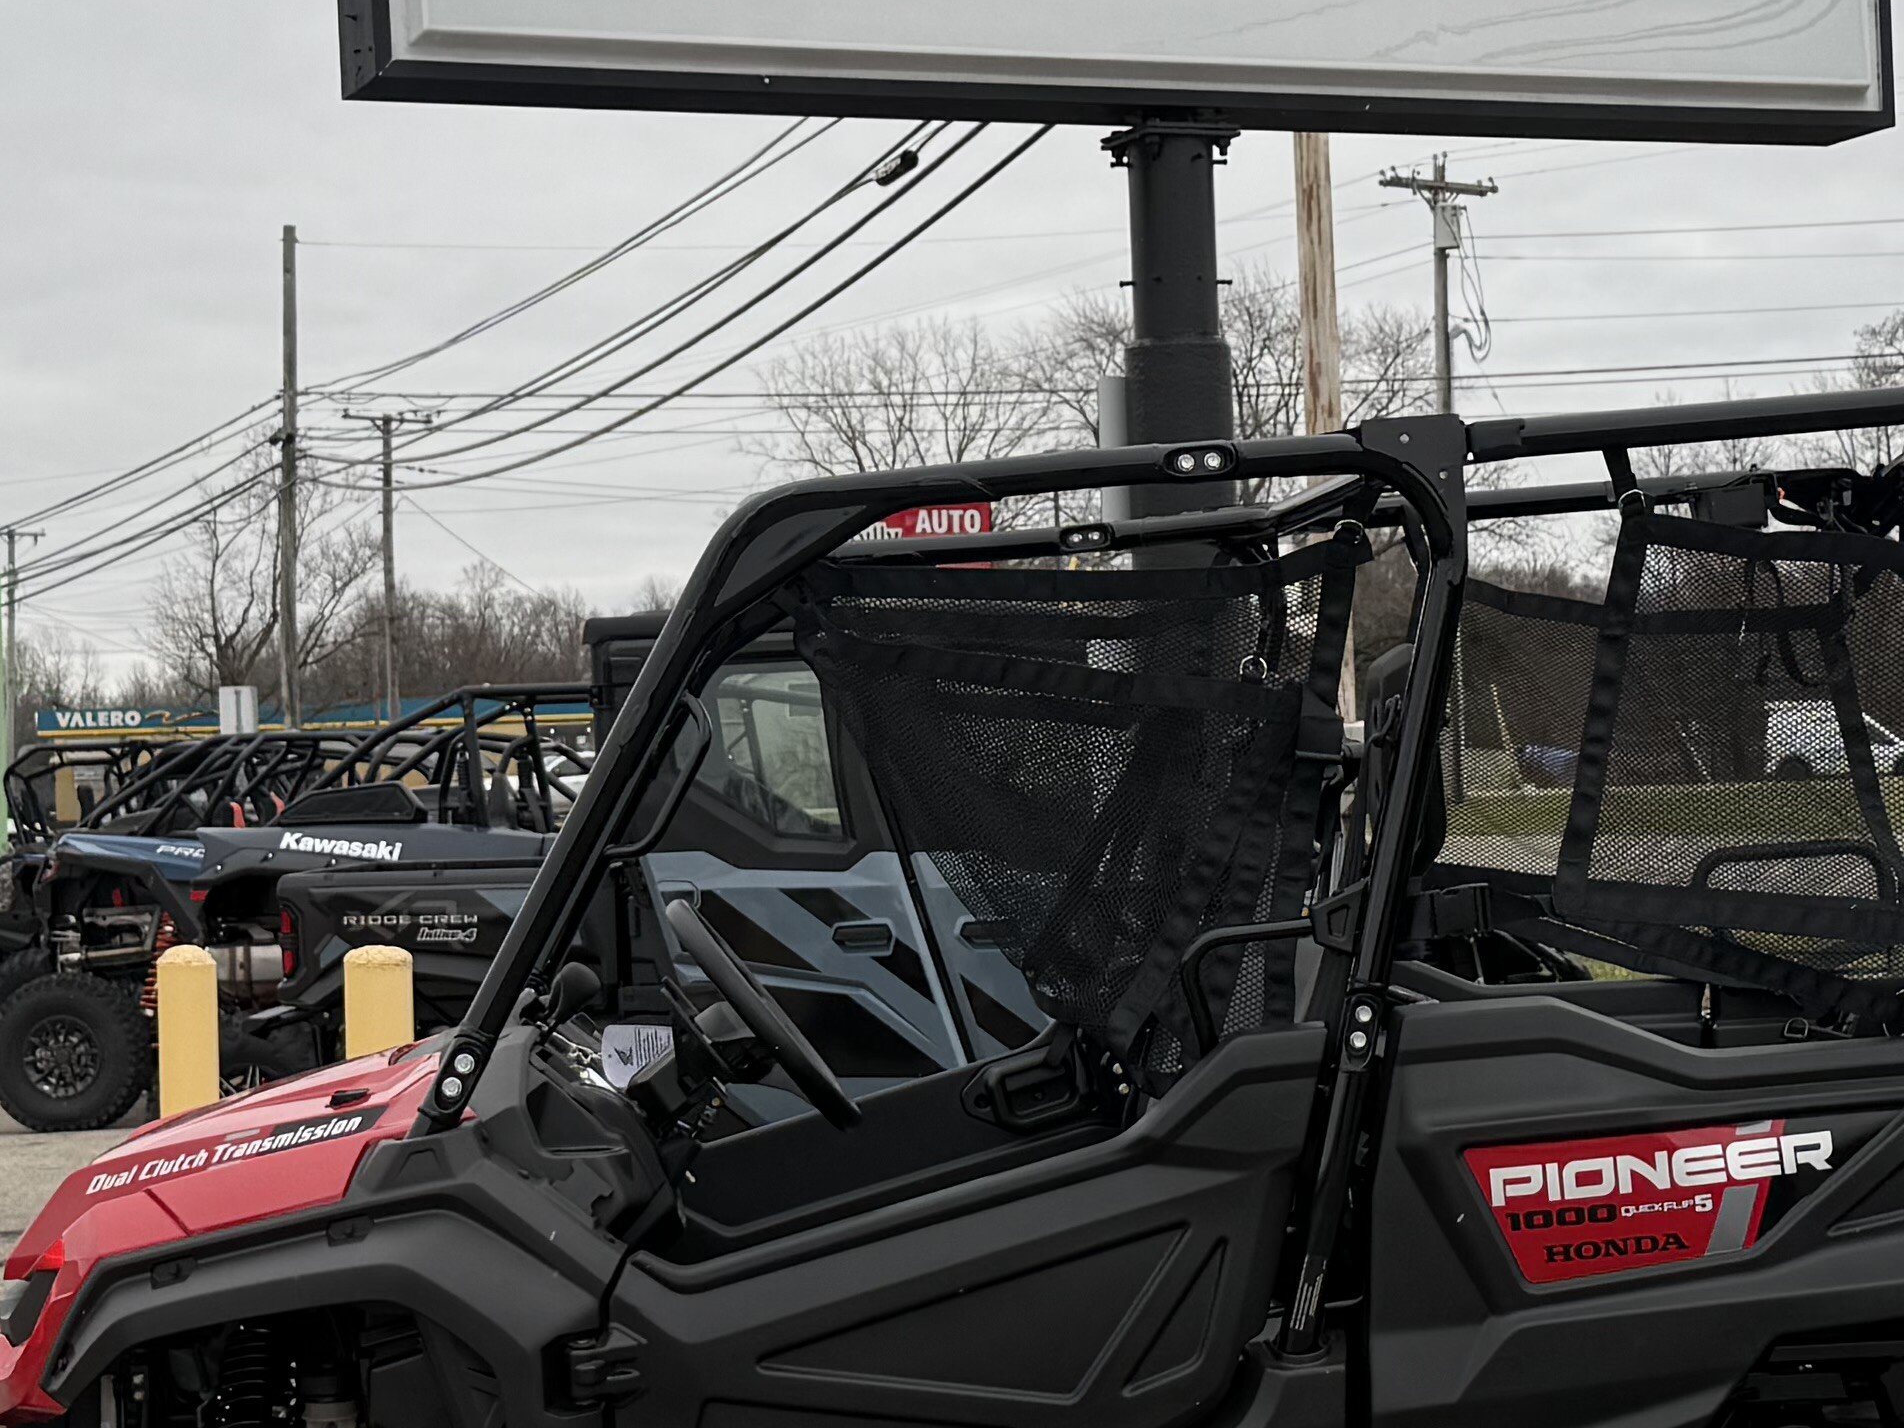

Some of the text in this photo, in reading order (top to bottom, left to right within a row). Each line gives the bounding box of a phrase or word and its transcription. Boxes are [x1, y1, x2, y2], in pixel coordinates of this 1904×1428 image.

[915, 509, 981, 533] AUTO
[55, 710, 142, 728] VALERO
[280, 831, 403, 862] Kawasaki
[343, 914, 478, 925] RIDGE CREW
[85, 1115, 364, 1196] Dual Clutch Transmission
[1489, 1130, 1834, 1208] PIONEER
[1504, 1203, 1618, 1233] 1000
[1694, 1193, 1713, 1213] 5
[1544, 1232, 1691, 1264] HONDA
